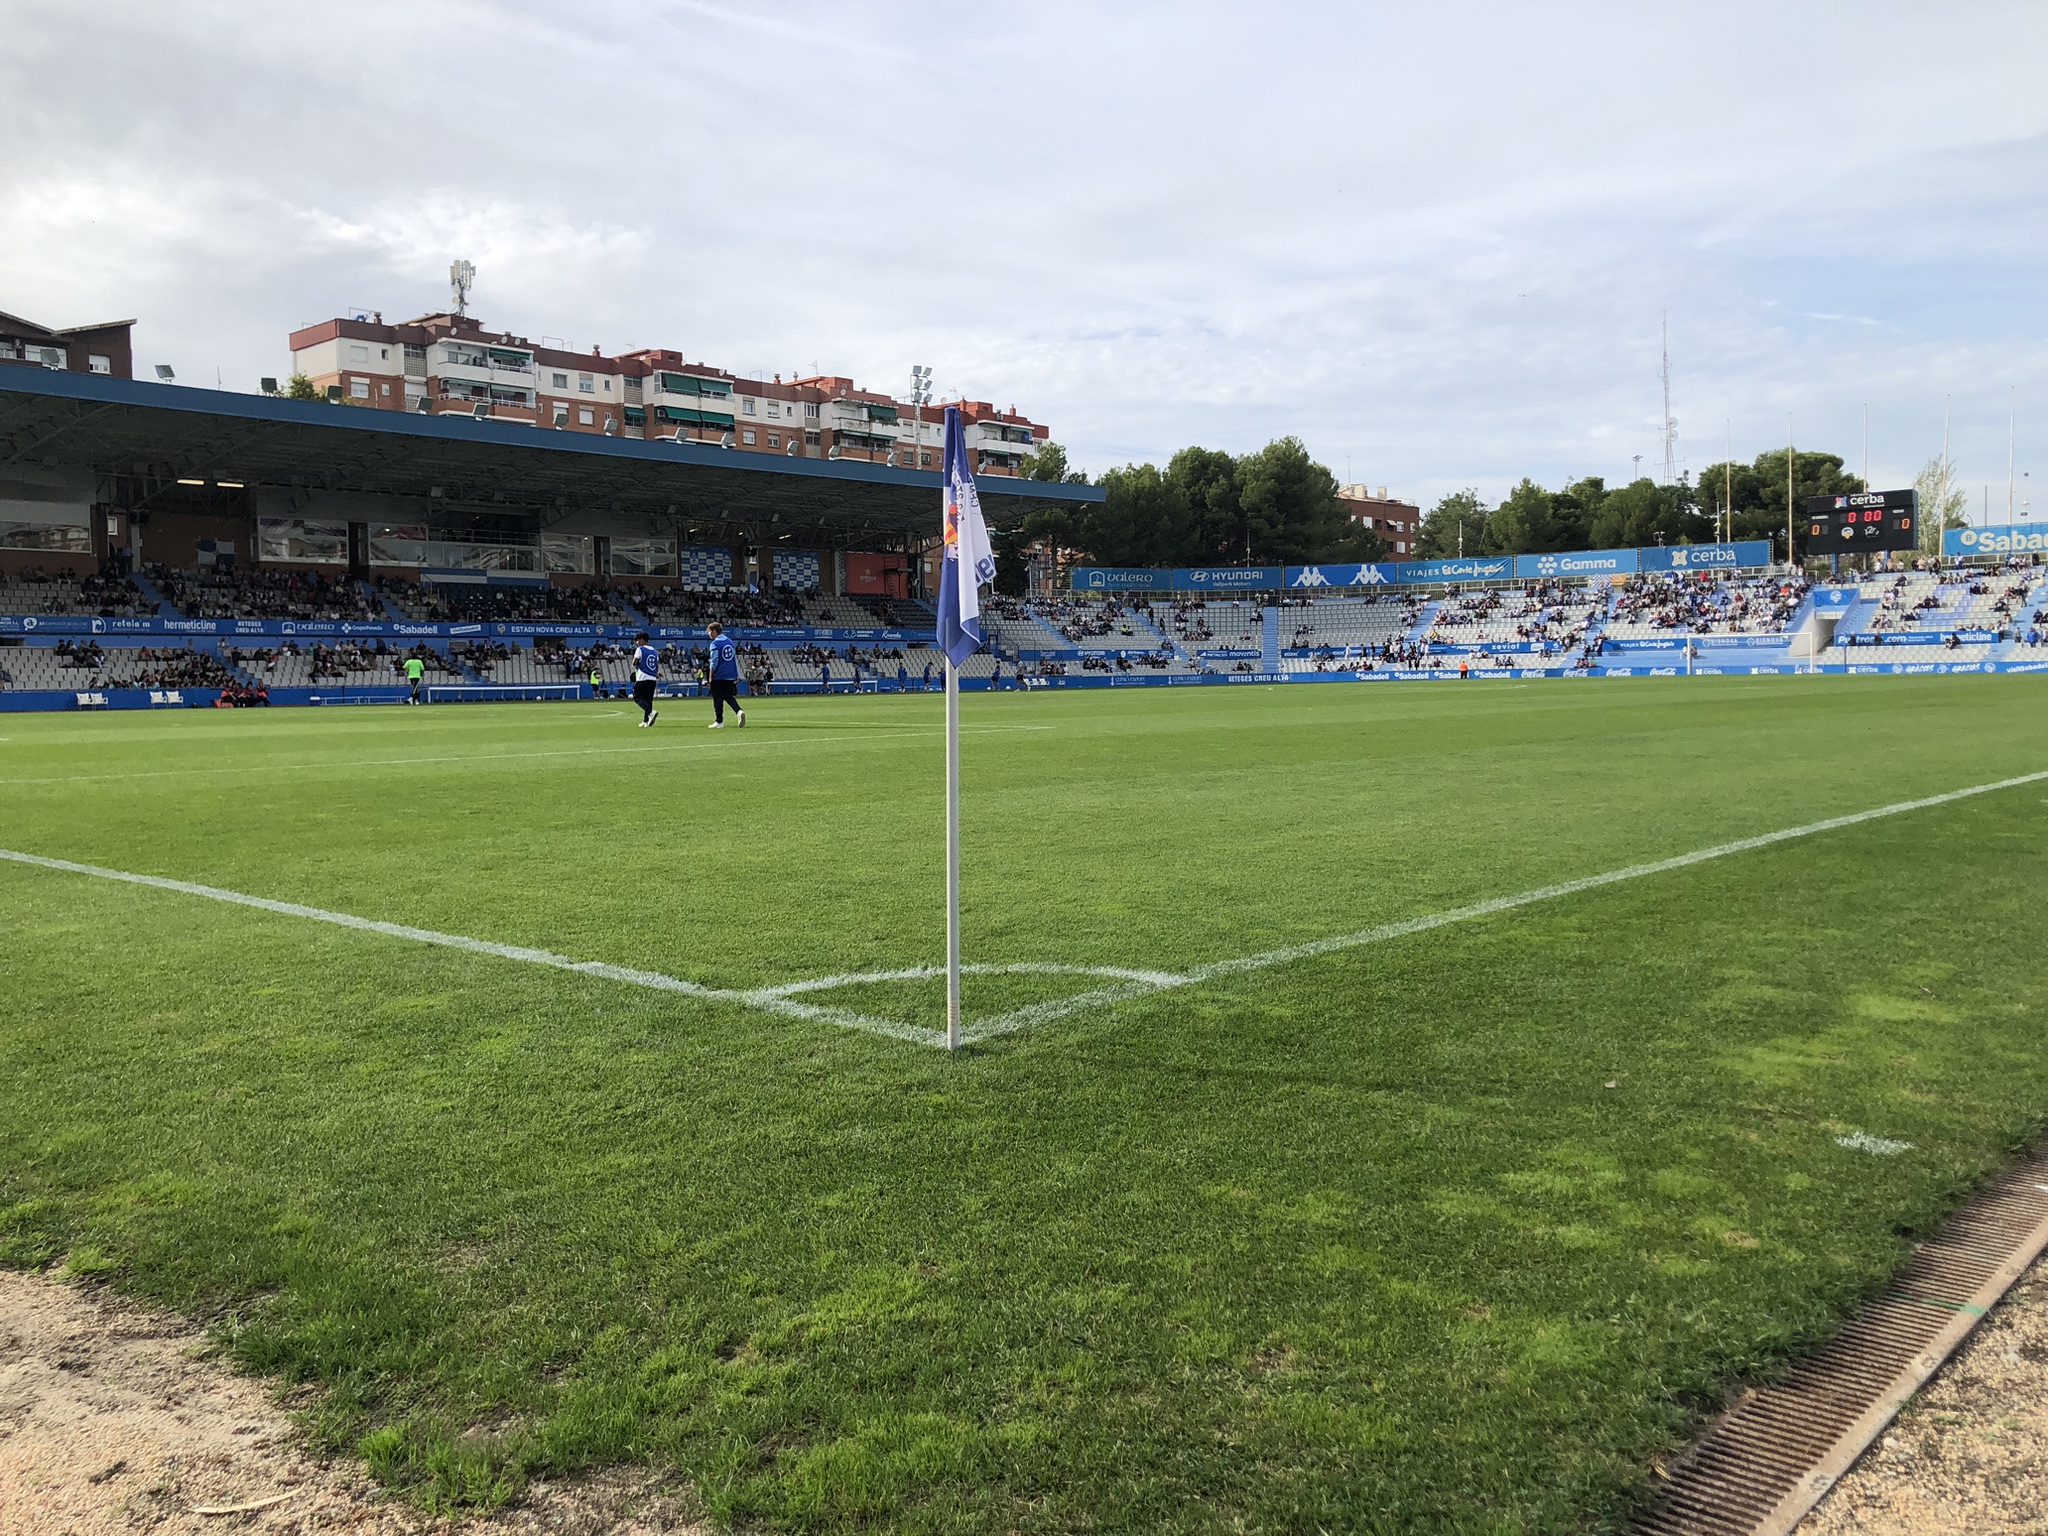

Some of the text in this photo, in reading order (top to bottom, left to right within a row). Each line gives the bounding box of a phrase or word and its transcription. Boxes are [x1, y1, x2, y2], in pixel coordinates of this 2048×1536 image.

[1850, 494, 1885, 505] cerba
[1848, 510, 1882, 523] 0 00
[1902, 518, 1910, 529] 0
[1812, 524, 1820, 536] 0
[1978, 531, 2048, 552] Saba
[1691, 548, 1736, 562] cerba
[1560, 558, 1616, 571] Gamma
[1212, 571, 1263, 580] HYUNDAI
[1406, 569, 1440, 577] VIAJES
[400, 625, 438, 635] Sabadell
